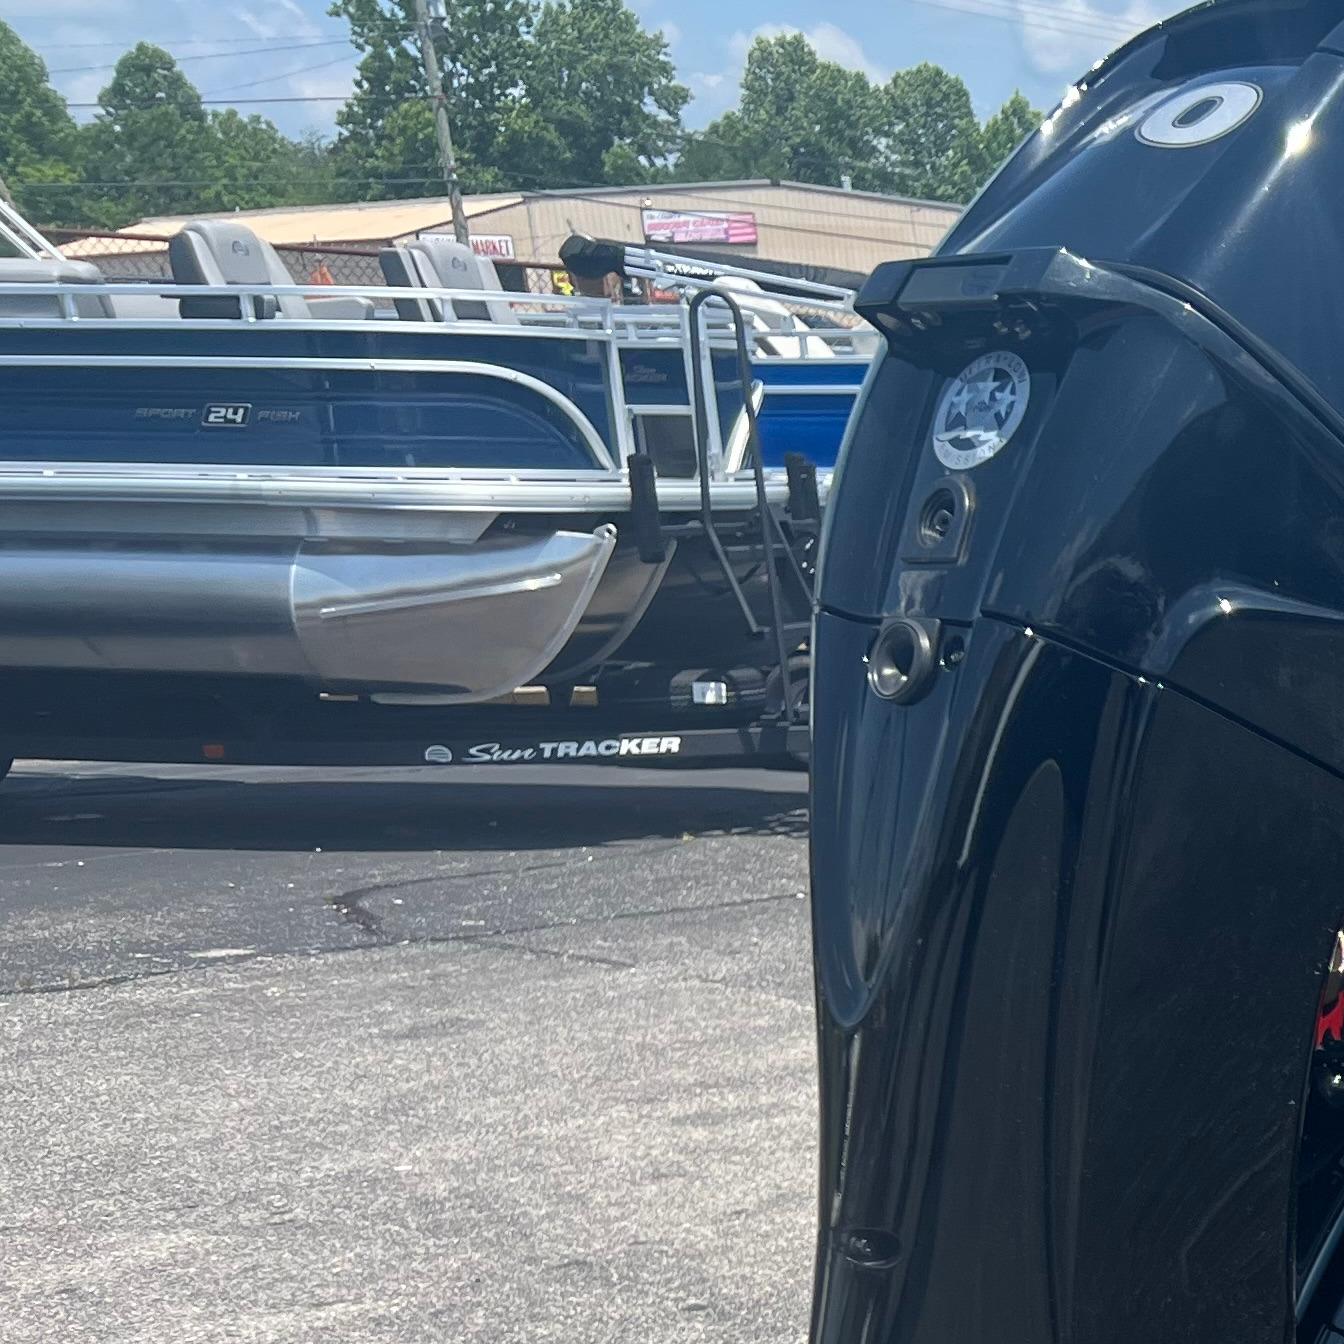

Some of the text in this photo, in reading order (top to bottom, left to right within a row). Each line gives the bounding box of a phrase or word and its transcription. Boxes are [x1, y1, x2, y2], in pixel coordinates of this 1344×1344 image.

[135, 407, 197, 419] SPORT
[207, 407, 245, 423] 24
[461, 736, 682, 763] Sun TRACKER
